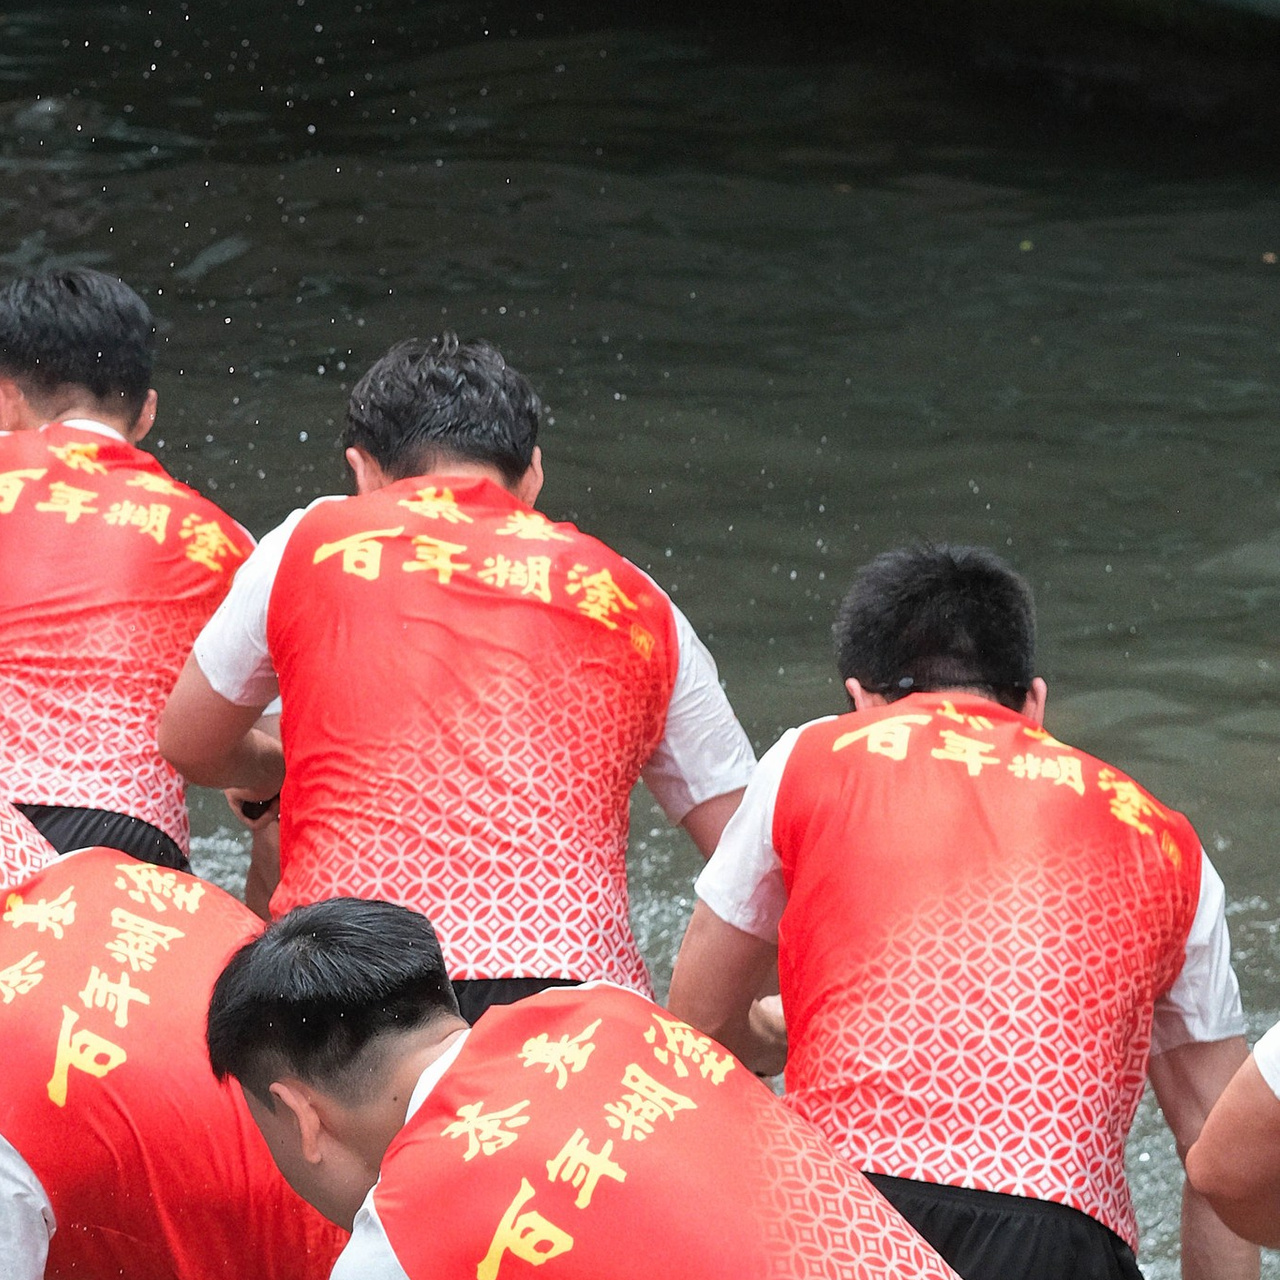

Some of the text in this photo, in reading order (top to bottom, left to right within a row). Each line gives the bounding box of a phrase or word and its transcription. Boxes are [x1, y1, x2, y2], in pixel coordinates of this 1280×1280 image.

[313, 525, 638, 631] 百年糊塗
[832, 714, 1159, 836] 百年糊塗
[46, 862, 206, 1108] 百年糊塗
[439, 1018, 603, 1162] 茶基
